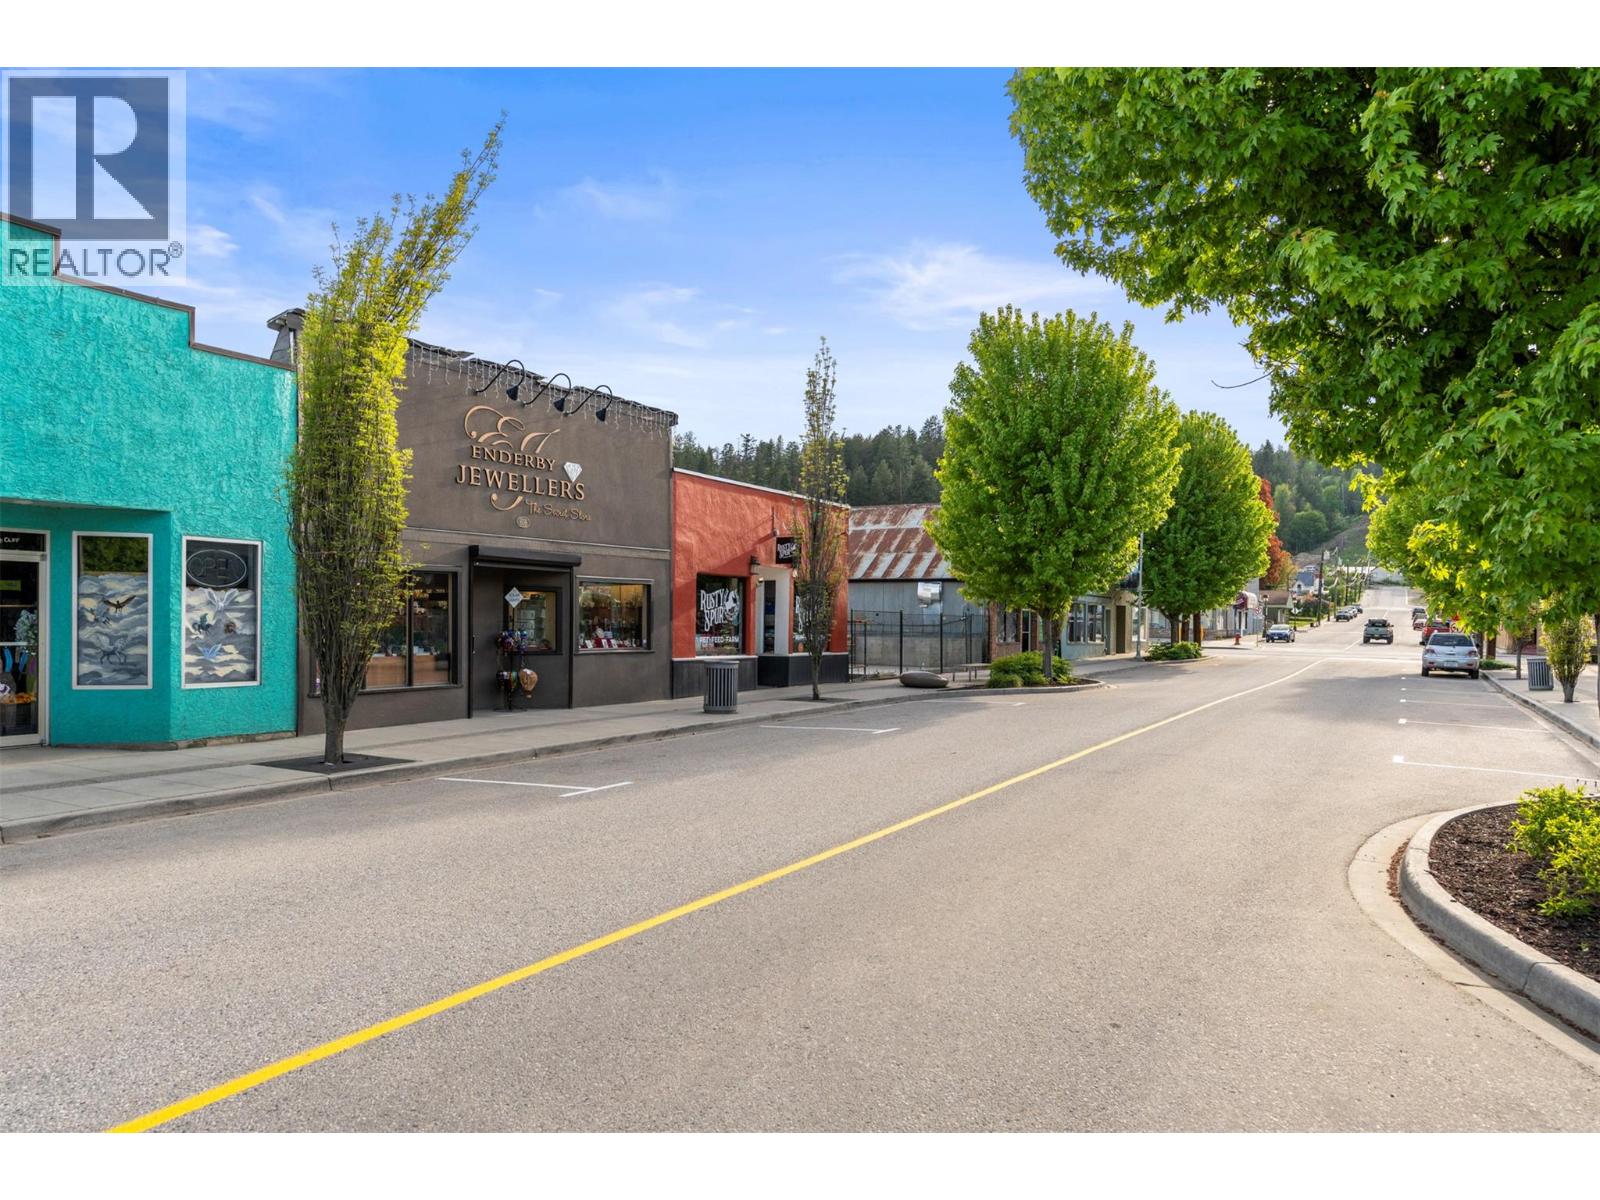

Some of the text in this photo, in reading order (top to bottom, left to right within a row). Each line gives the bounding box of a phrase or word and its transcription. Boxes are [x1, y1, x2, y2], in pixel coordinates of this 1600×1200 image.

[471, 445, 556, 471] ENDERBY
[456, 464, 585, 500] JEWELLERS
[525, 499, 541, 515] The
[700, 588, 725, 611] RUSTY
[704, 607, 724, 632] SPUR
